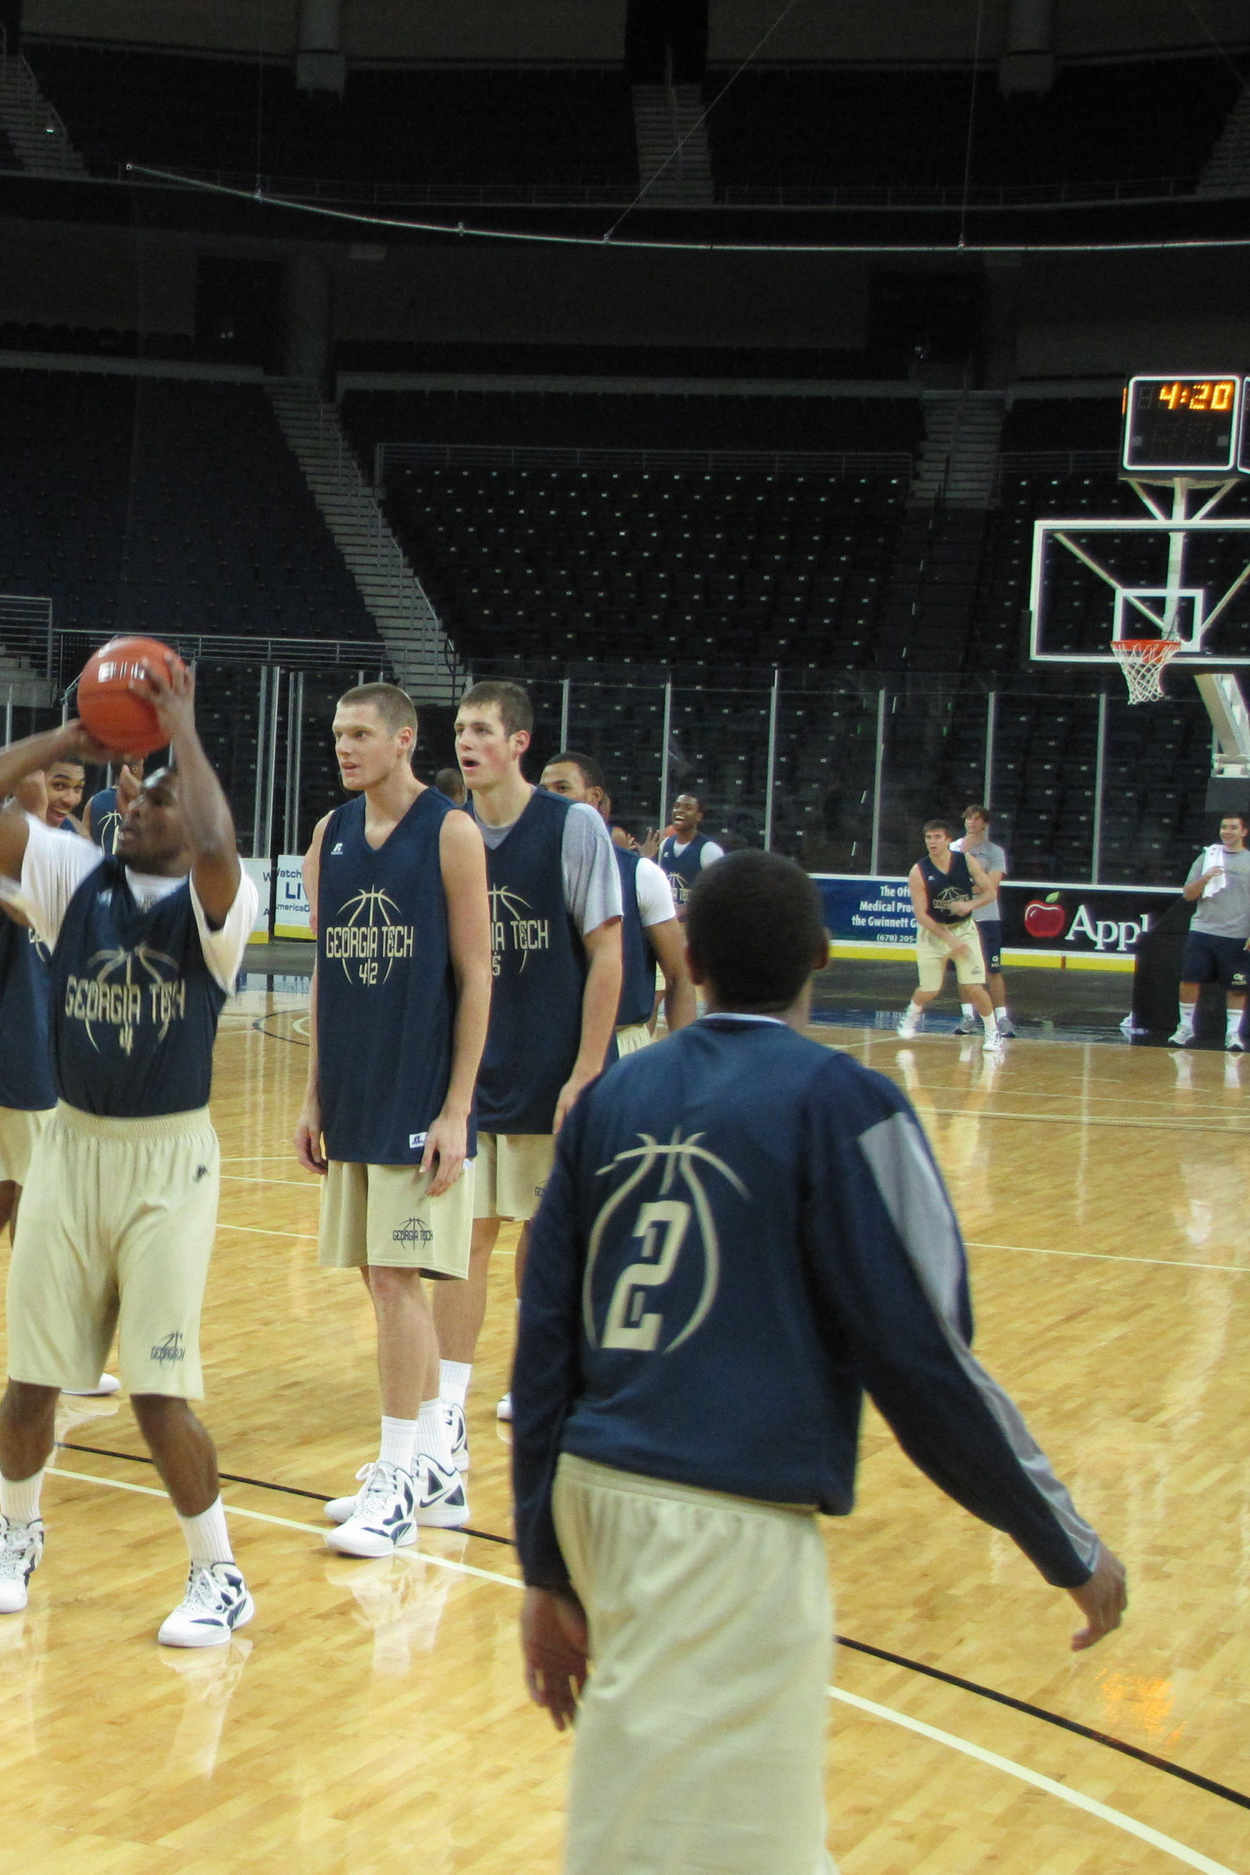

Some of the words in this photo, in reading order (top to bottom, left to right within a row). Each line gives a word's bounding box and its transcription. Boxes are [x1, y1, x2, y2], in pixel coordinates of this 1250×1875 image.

[1159, 383, 1233, 410] 4:20
[880, 885, 896, 897] The
[859, 900, 895, 912] Medical
[851, 914, 866, 926] the
[867, 916, 909, 928] Gwinnett
[326, 927, 379, 958] GEORGIA
[382, 926, 414, 957] TECH
[510, 920, 549, 949] TECH
[876, 934, 898, 943] (678)
[358, 963, 379, 985] 42
[65, 975, 140, 1025] GEORGIA
[392, 1229, 418, 1241] GEORGIA
[601, 1200, 691, 1350] 2
